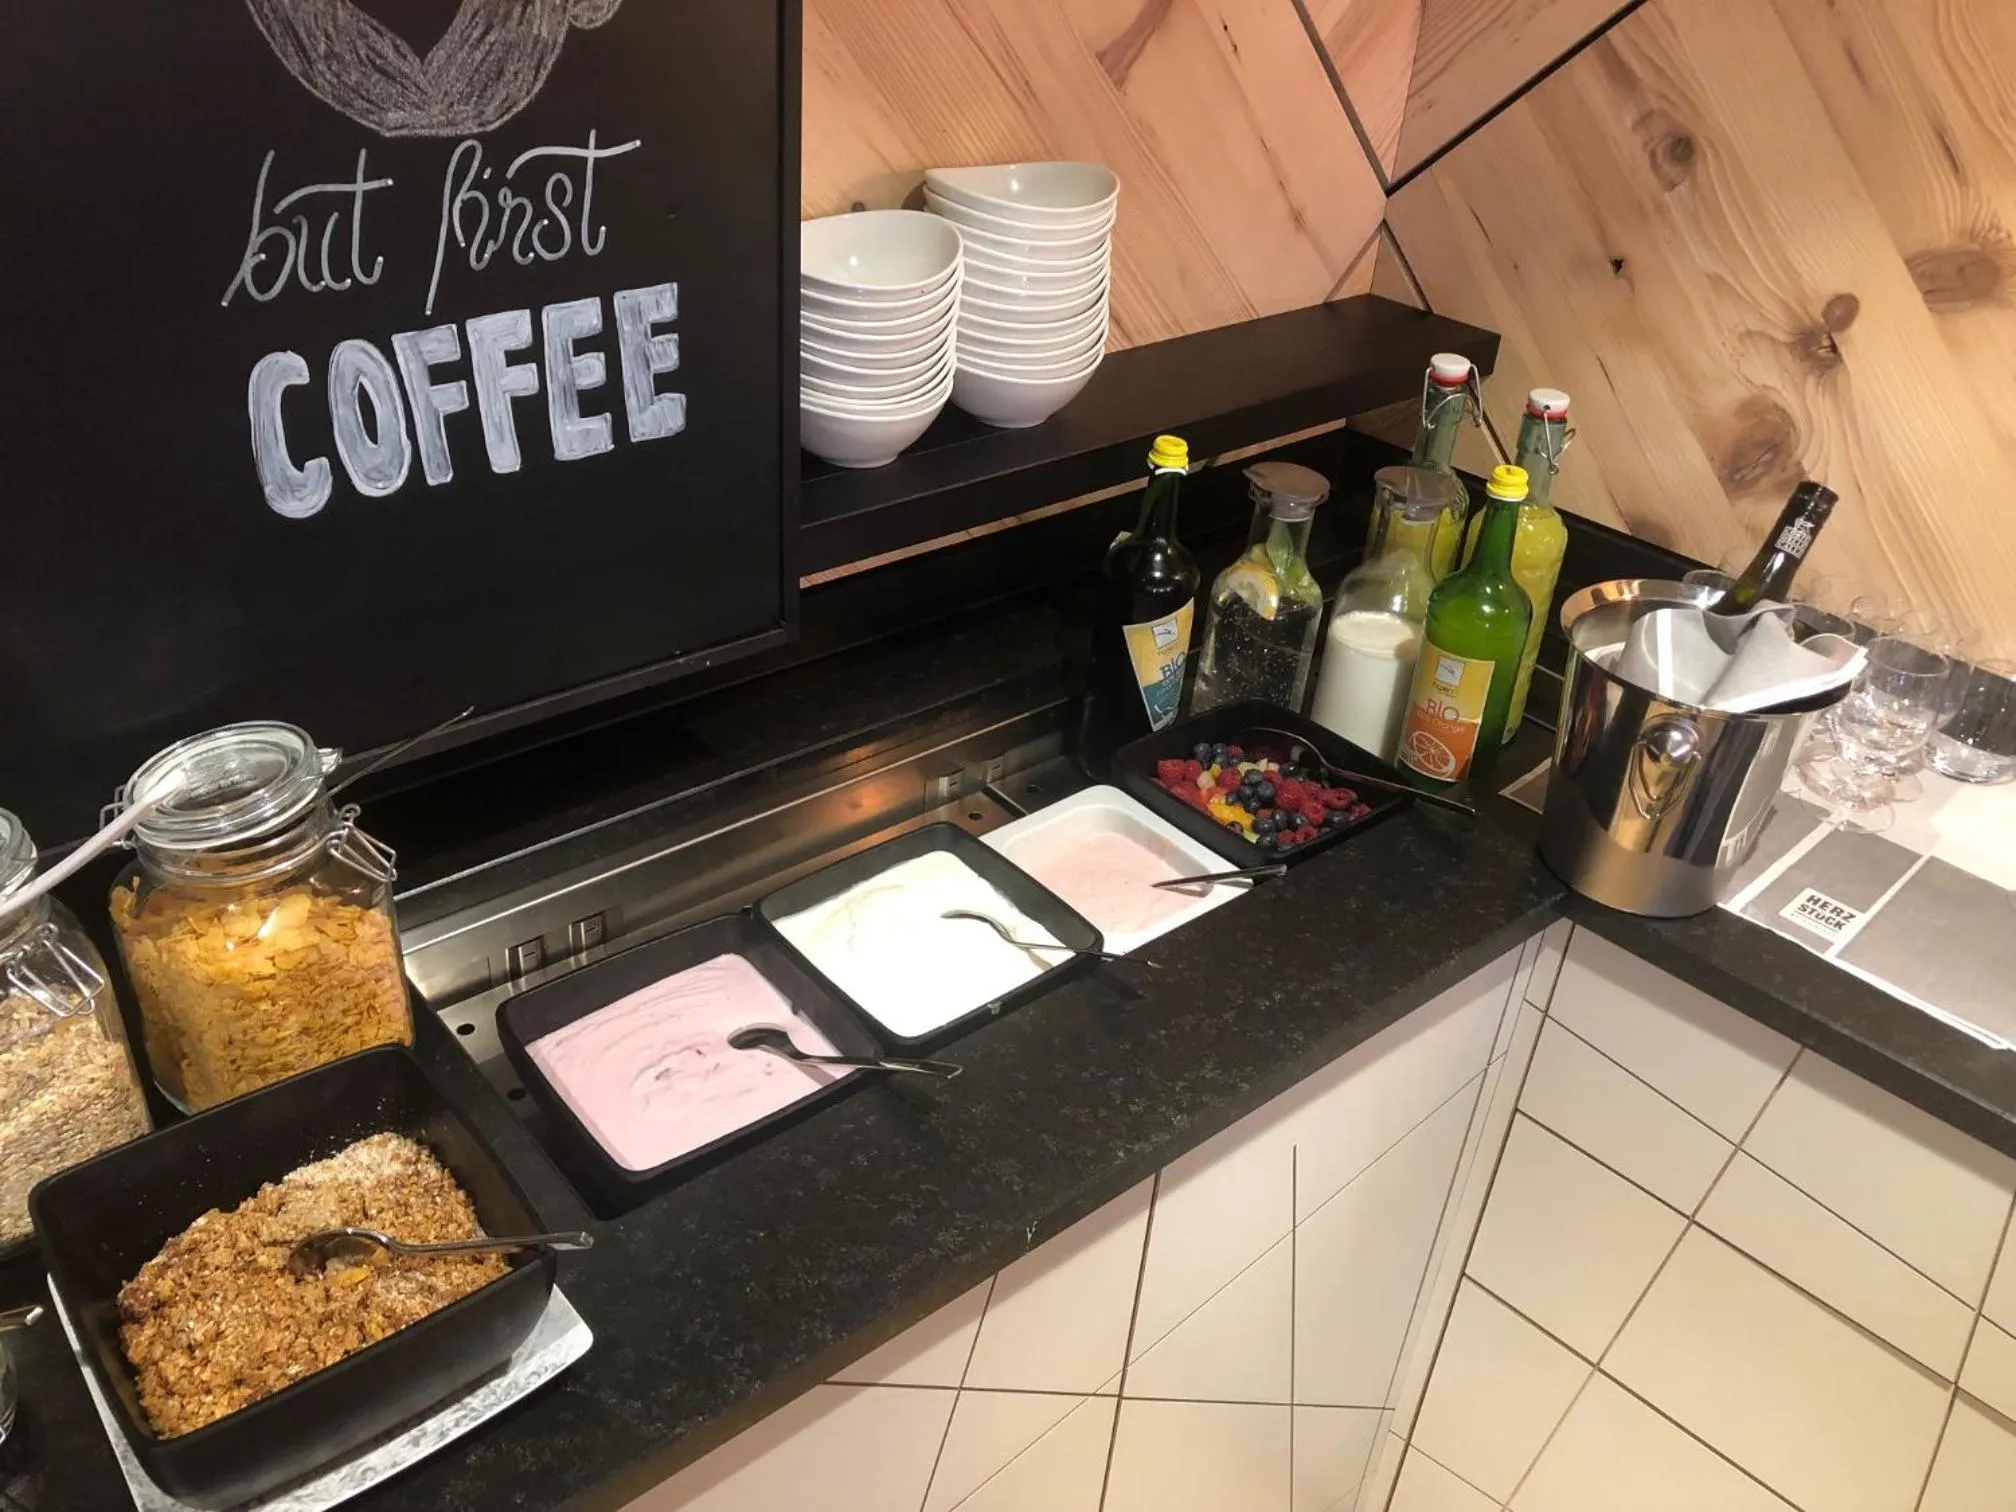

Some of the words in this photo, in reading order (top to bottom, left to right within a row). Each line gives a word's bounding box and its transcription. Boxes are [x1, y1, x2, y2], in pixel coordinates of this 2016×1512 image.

[221, 149, 393, 307] but
[426, 129, 642, 315] first
[248, 282, 688, 518] COFFEE
[1806, 894, 1857, 923] HERZ
